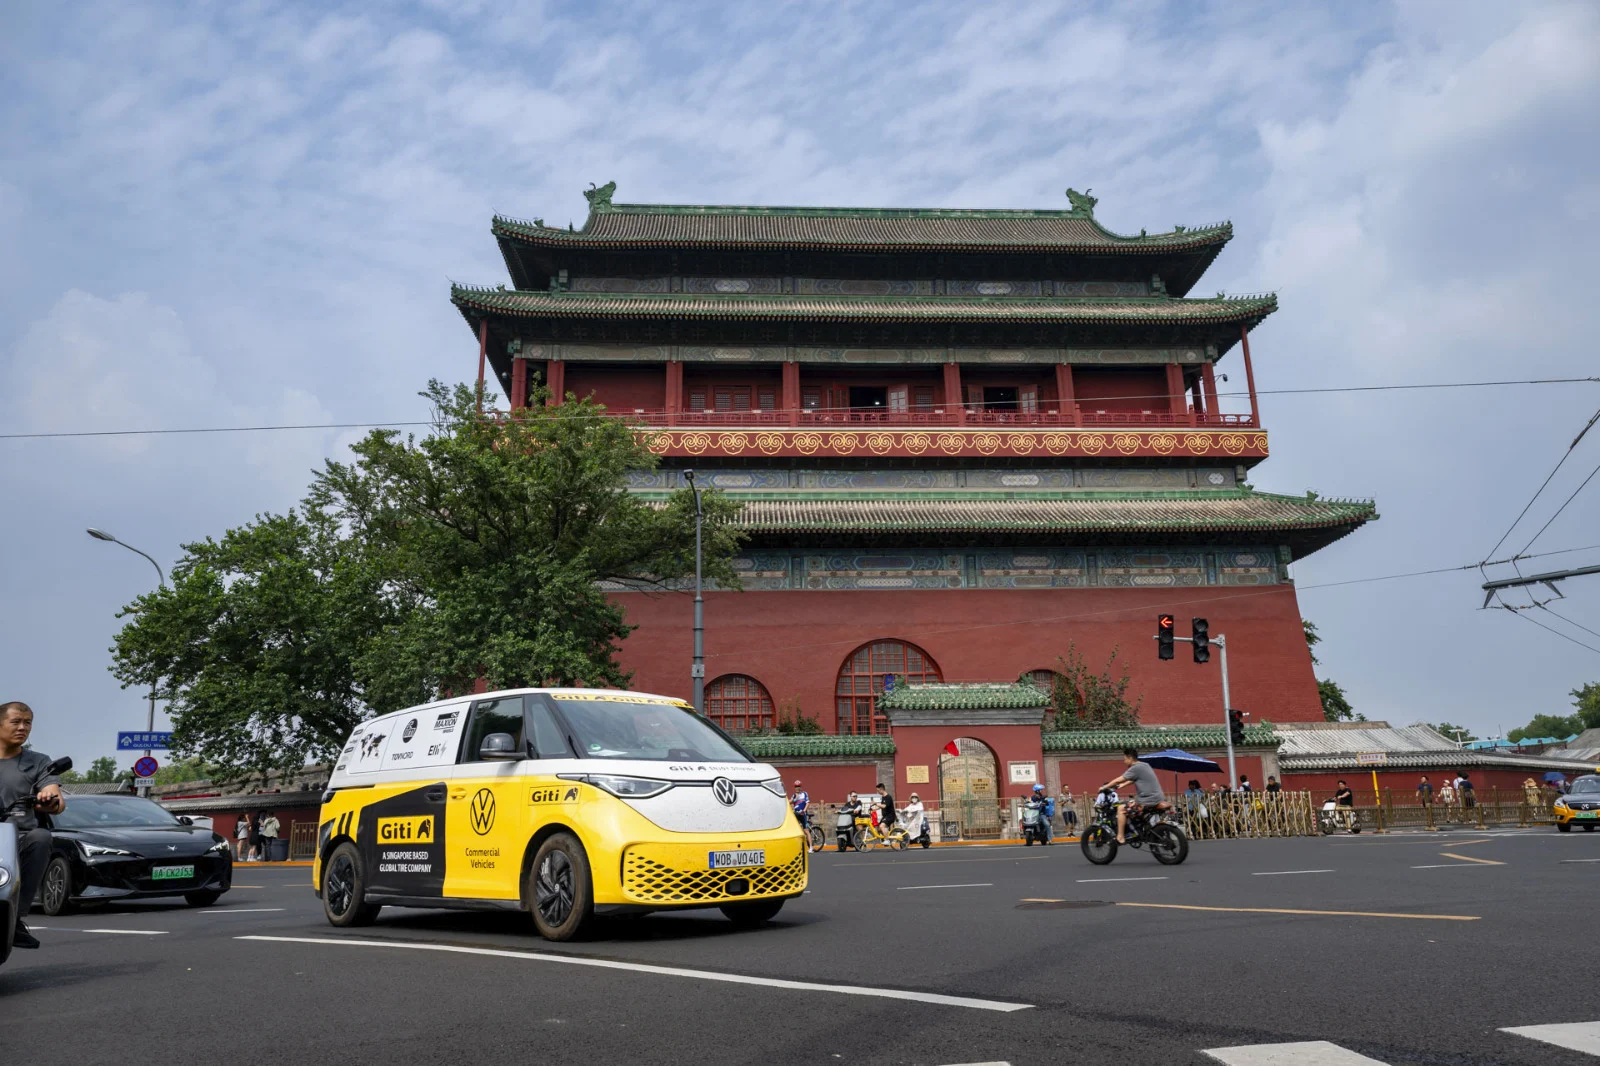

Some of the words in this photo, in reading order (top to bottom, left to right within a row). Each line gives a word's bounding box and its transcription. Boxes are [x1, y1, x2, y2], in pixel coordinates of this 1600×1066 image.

[531, 789, 560, 803] Giti
[381, 822, 411, 840] Giti
[382, 851, 387, 860] A
[386, 851, 412, 860] SINGAPORE
[412, 851, 429, 860] BASED
[465, 847, 500, 857] Commercial
[379, 863, 397, 872] GLOBAL
[397, 863, 408, 872] TIRE
[407, 863, 432, 873] COMPANY
[470, 860, 495, 869] Vehicles
